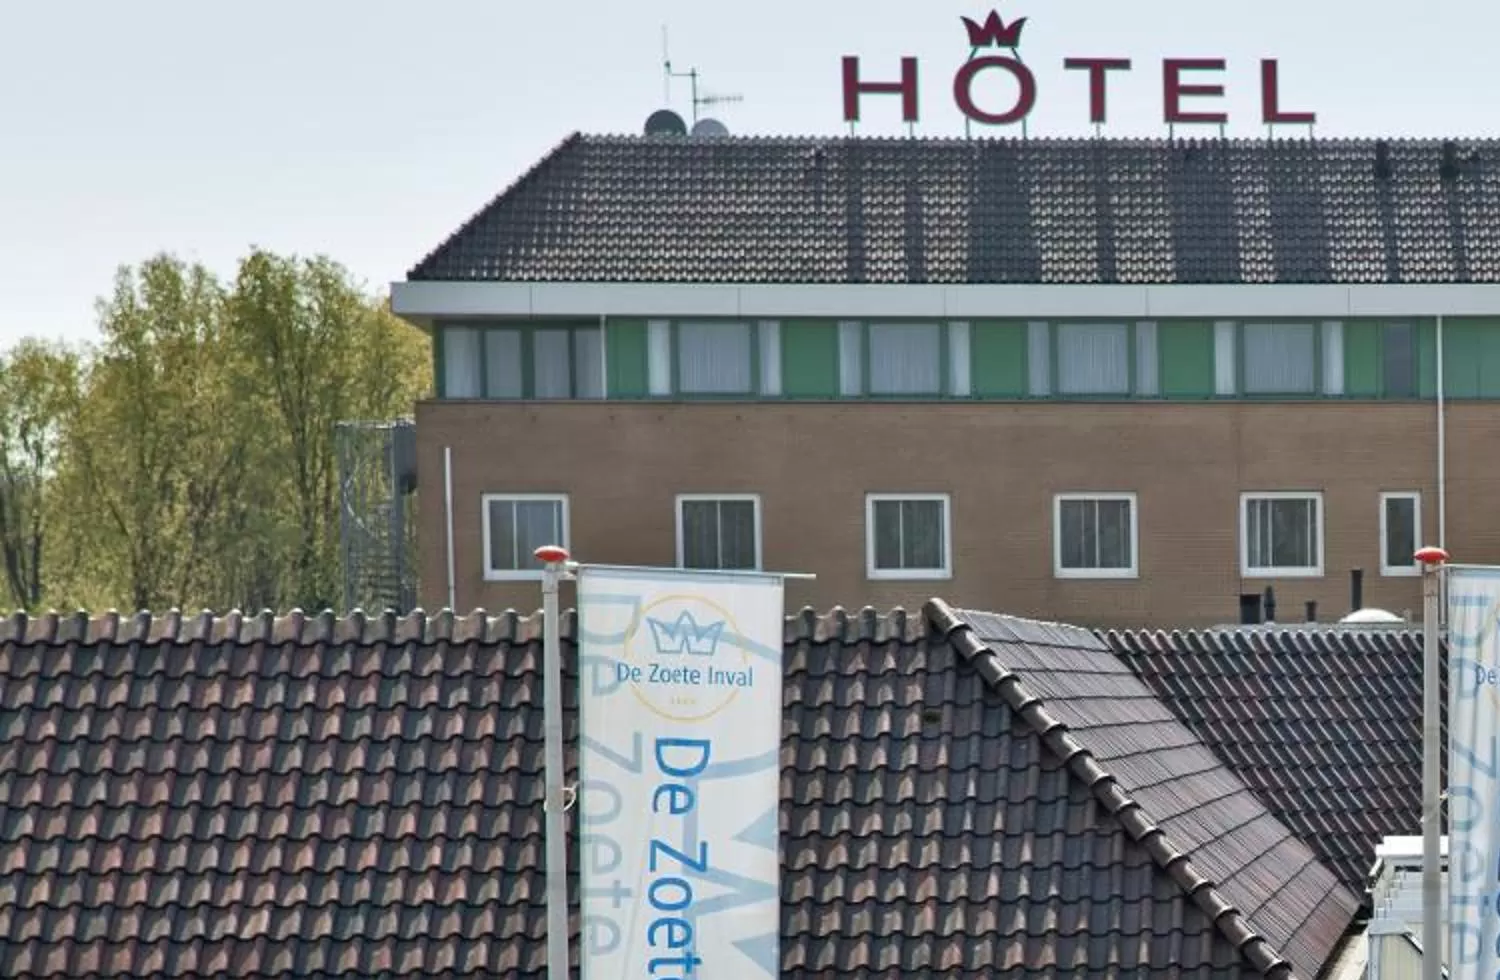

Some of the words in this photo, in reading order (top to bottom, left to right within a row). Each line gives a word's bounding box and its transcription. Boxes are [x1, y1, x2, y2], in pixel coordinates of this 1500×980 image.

[616, 662, 642, 684] De
[647, 663, 701, 685] Zoete
[707, 664, 753, 687] Inval
[1475, 663, 1497, 686] De
[652, 737, 711, 815] De
